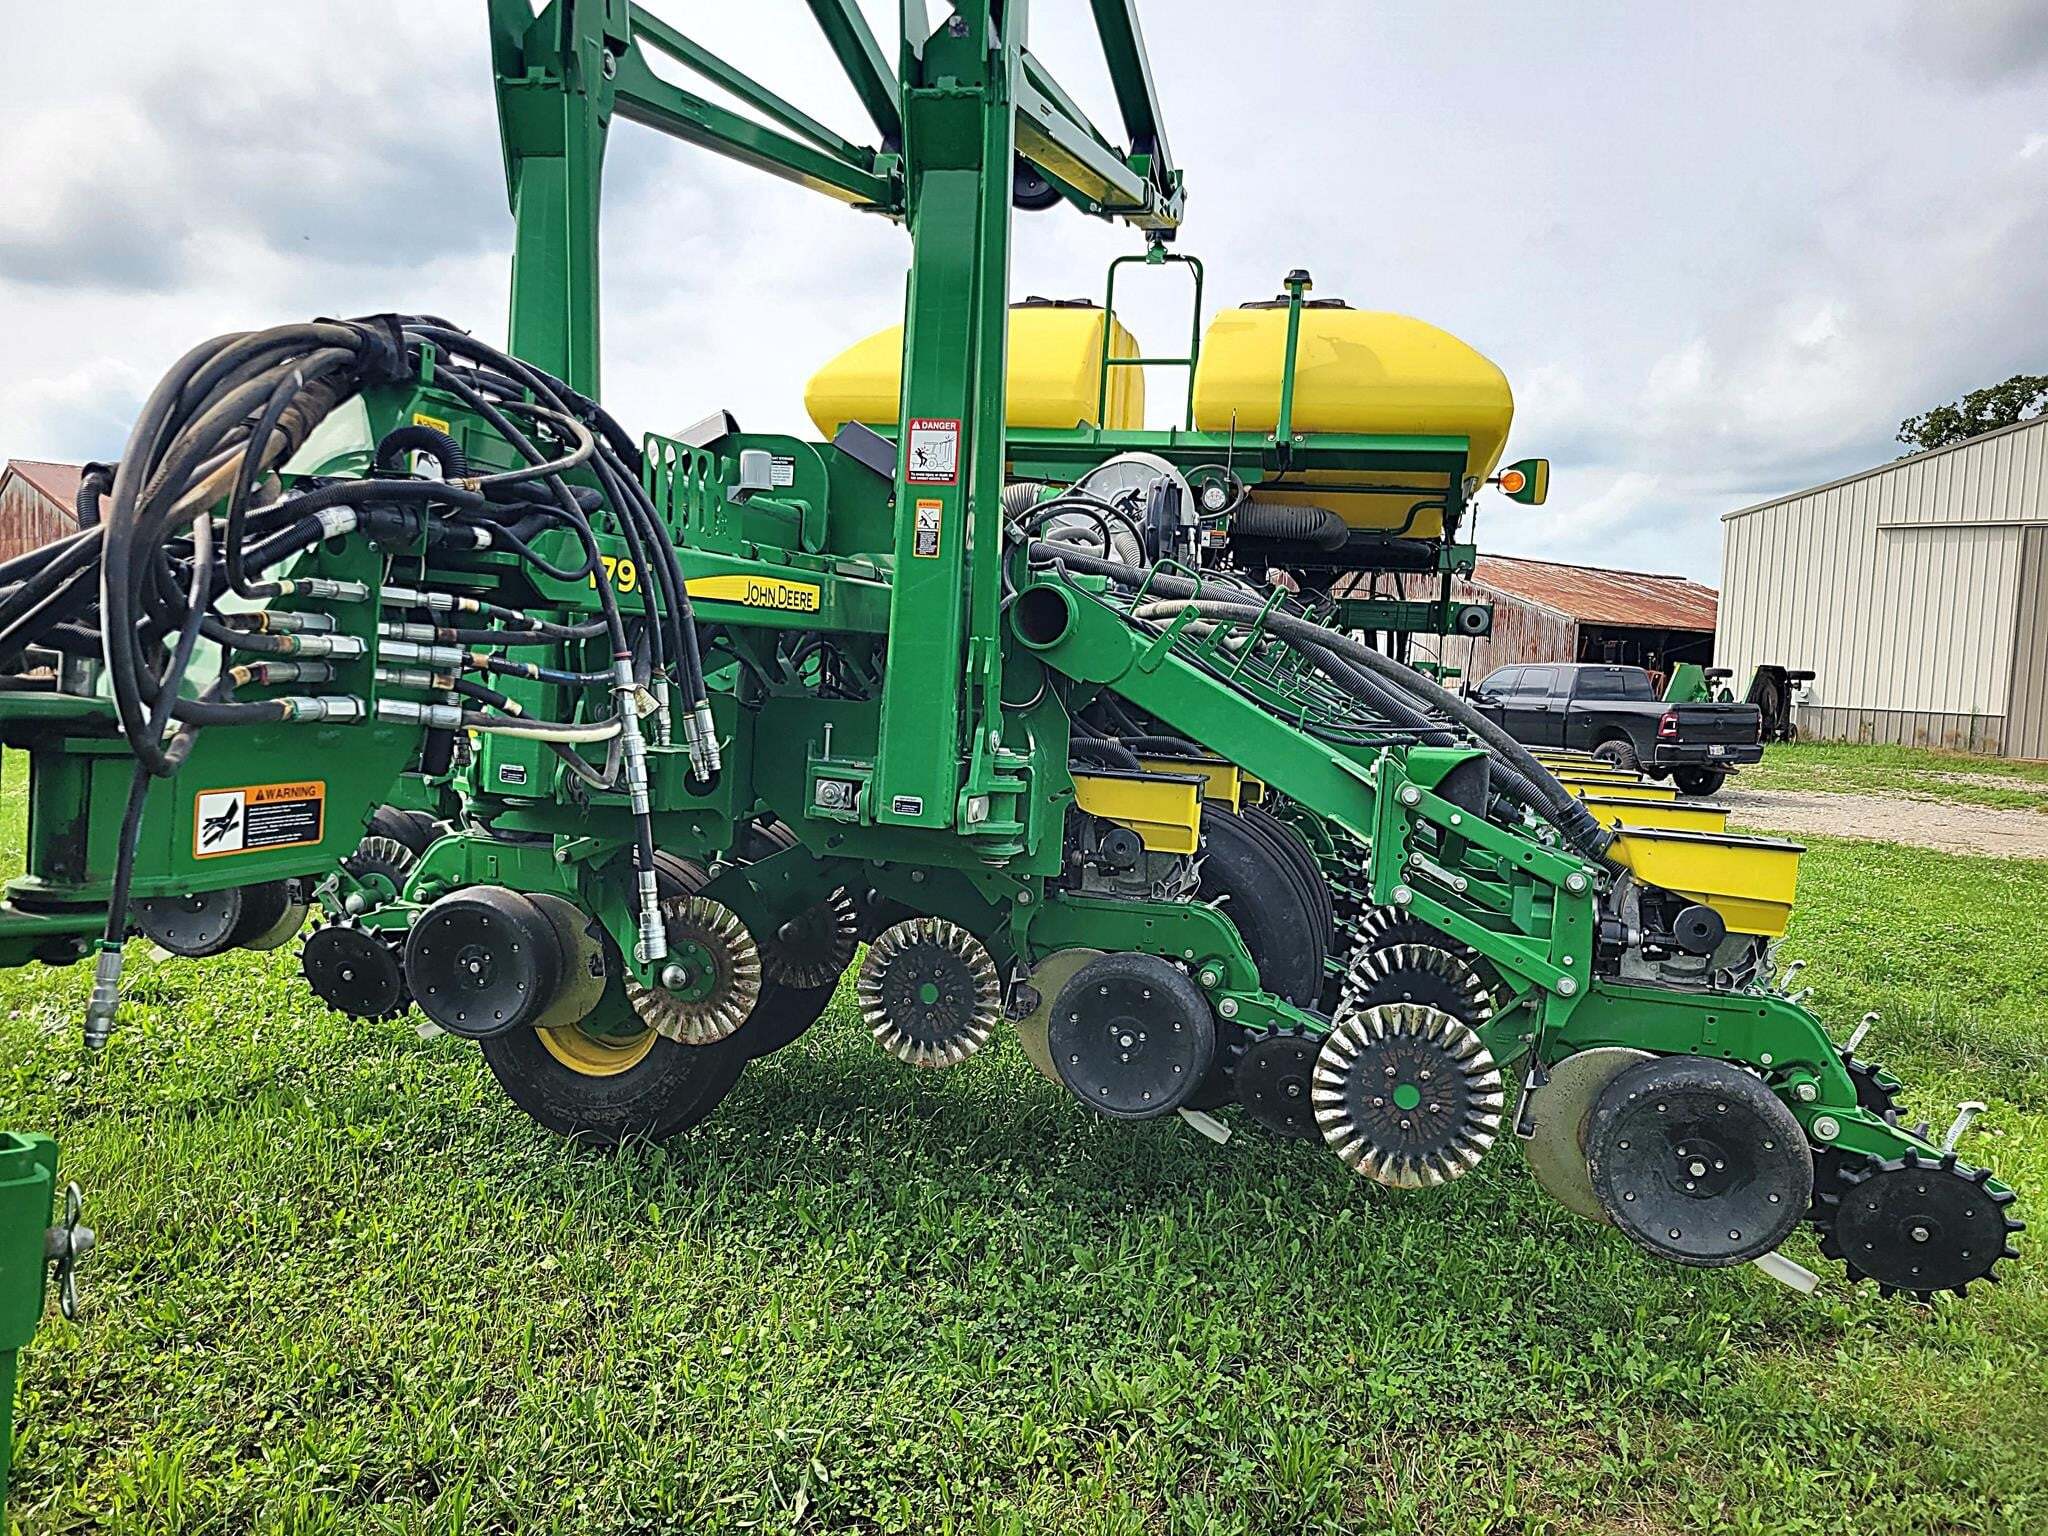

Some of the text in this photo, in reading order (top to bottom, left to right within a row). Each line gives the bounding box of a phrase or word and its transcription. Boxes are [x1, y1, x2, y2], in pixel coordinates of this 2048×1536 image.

[921, 421, 957, 430] DANGER
[588, 555, 653, 594] 79
[743, 579, 814, 610] JOHN DEERE
[265, 785, 317, 800] WARNING
